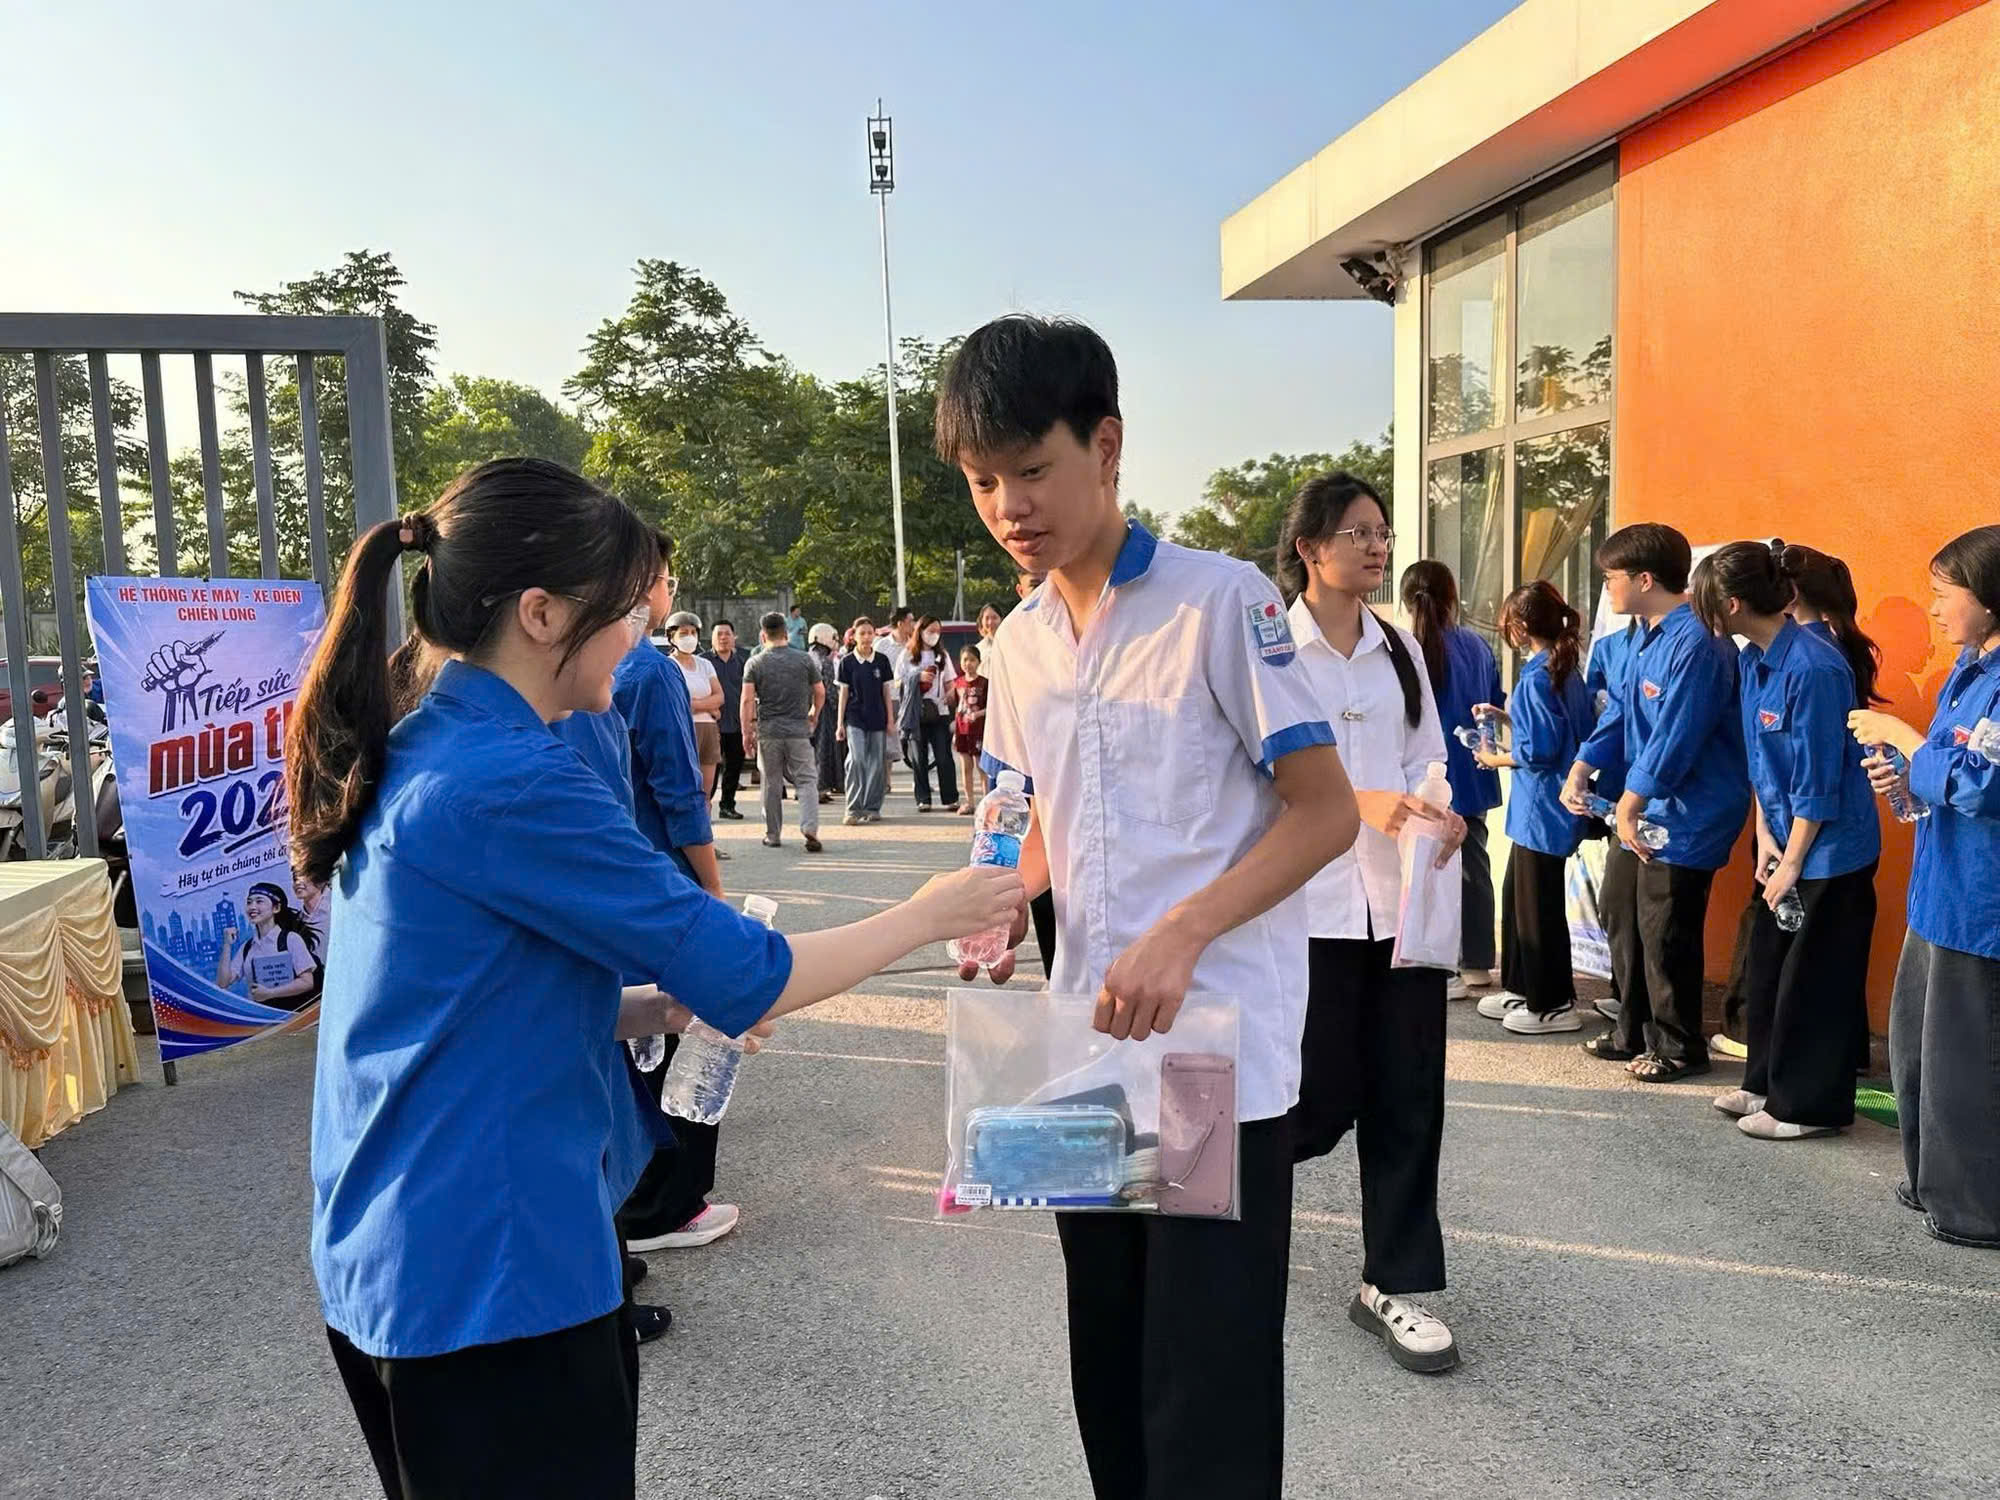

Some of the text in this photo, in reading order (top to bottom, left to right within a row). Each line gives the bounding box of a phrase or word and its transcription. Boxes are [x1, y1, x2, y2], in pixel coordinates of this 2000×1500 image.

[119, 585, 138, 605] HỆ
[141, 584, 188, 602] THỐNG
[191, 588, 208, 602] XE
[212, 586, 240, 602] MÁY
[253, 589, 270, 602] XE
[273, 586, 302, 606] ĐIỆN
[178, 603, 256, 621] CHIẾN LONG
[198, 667, 291, 716] Tiếp sức
[149, 721, 254, 795] mùa
[180, 770, 289, 857] 202
[178, 873, 199, 889] Hãy
[201, 868, 214, 883] tự
[215, 863, 230, 877] tin
[231, 855, 261, 872] chúng
[263, 847, 276, 861] tôi
